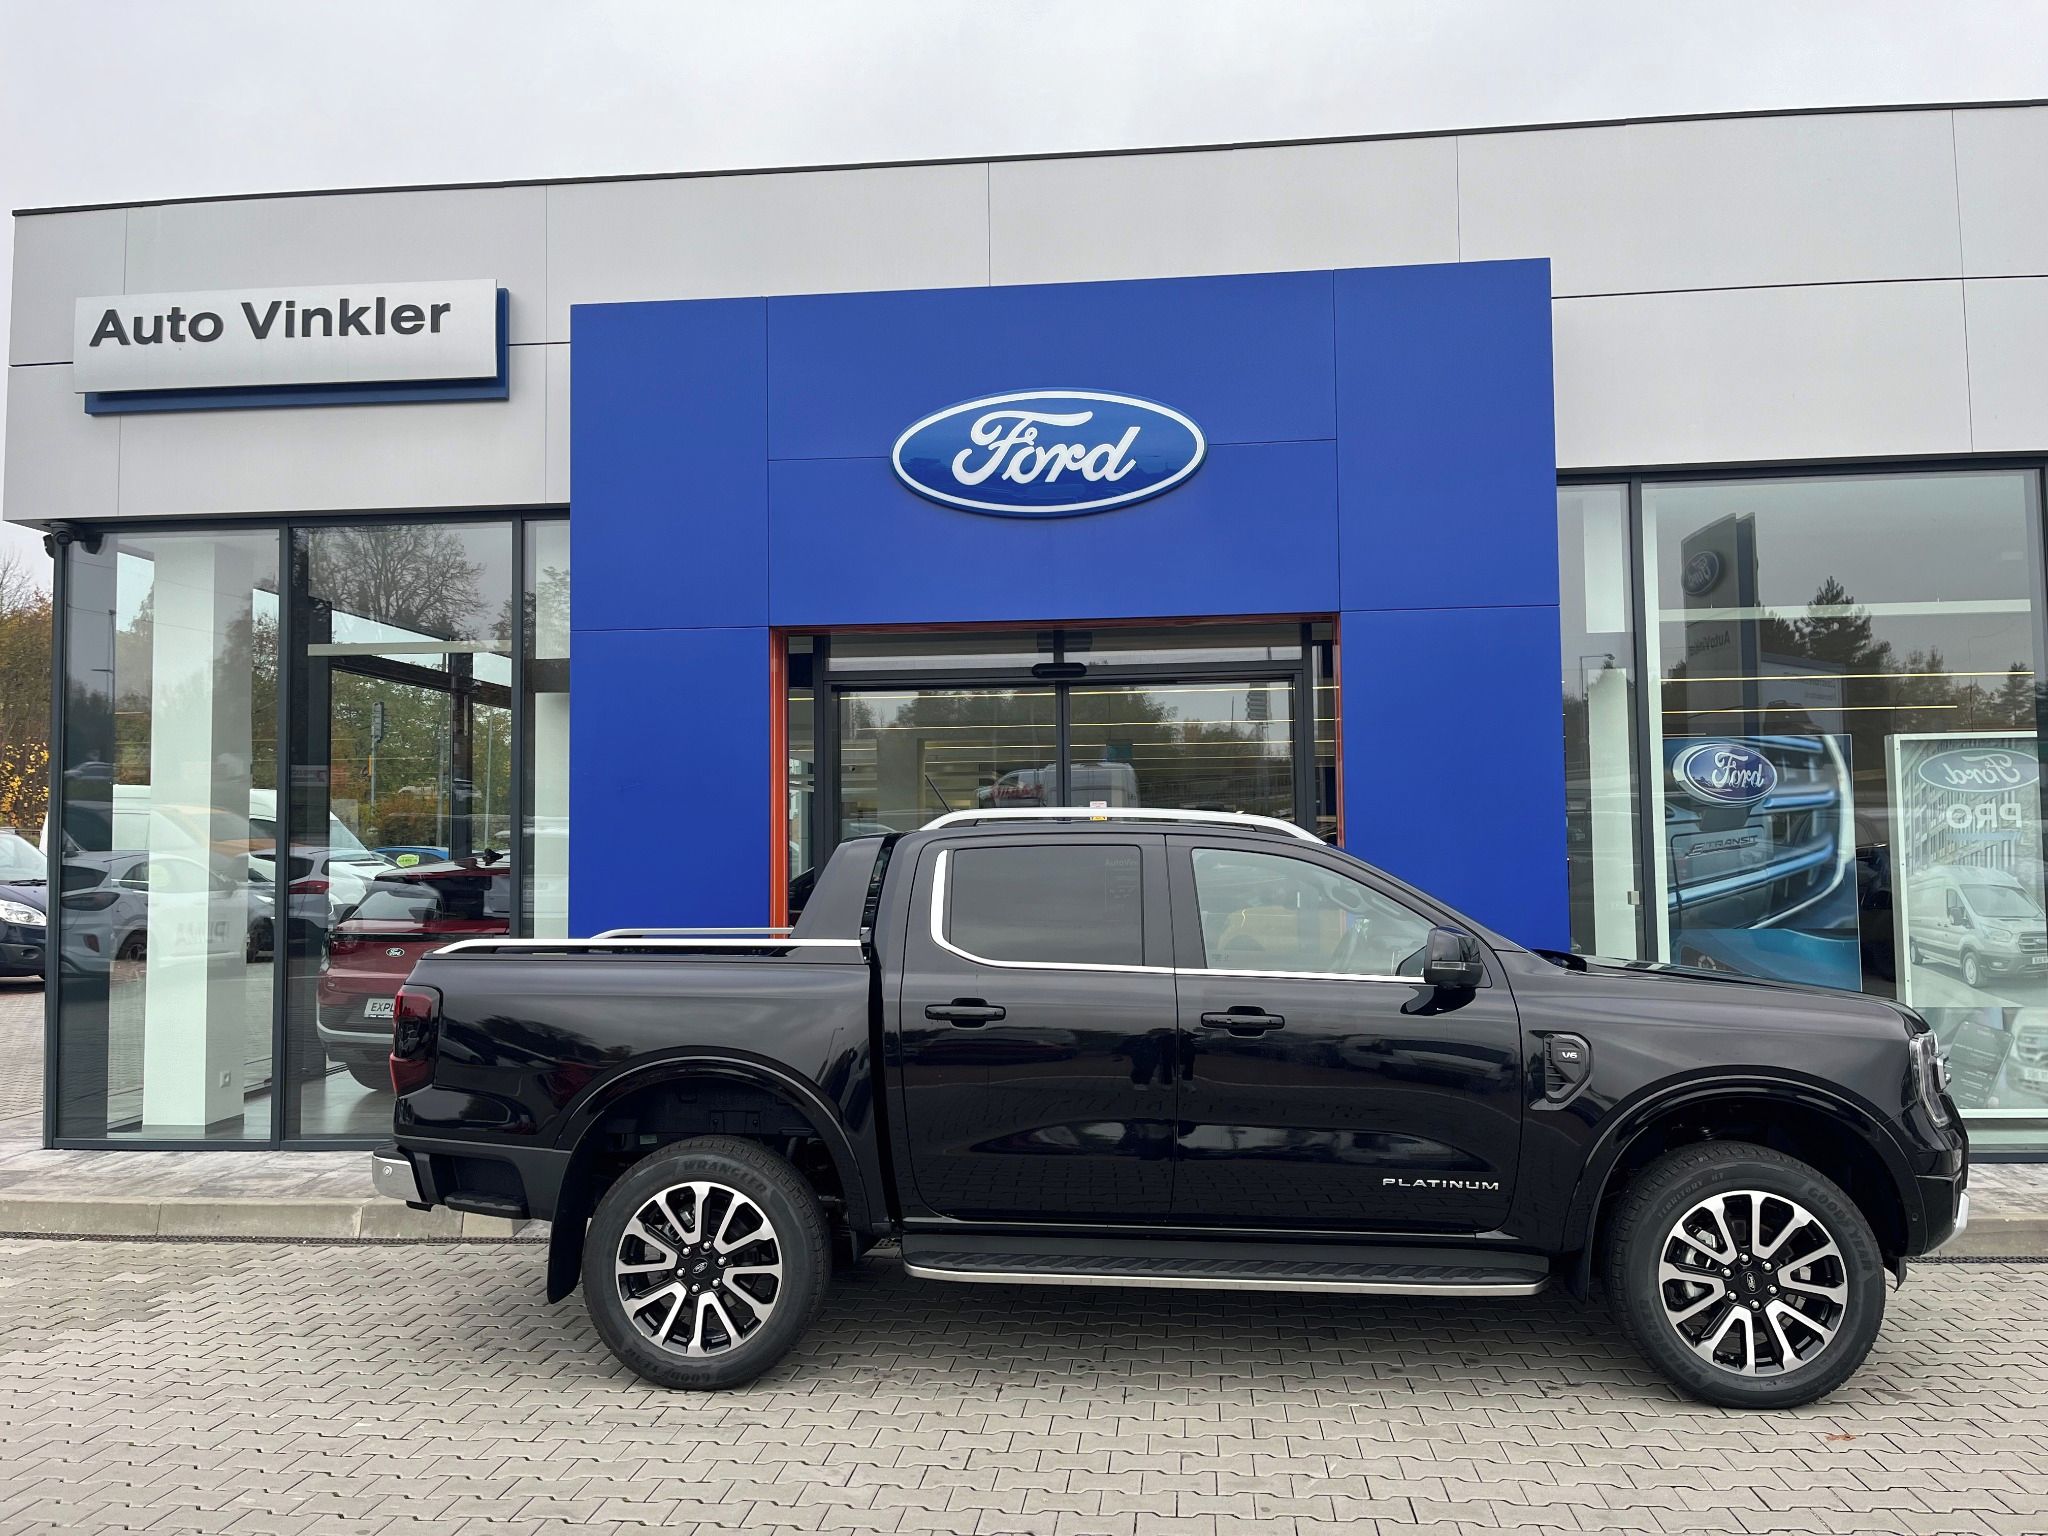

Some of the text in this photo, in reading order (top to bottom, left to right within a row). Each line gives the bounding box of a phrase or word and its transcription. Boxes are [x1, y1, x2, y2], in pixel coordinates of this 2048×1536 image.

[89, 296, 452, 347] Auto Vinkler
[951, 410, 1141, 486] Ford
[1711, 751, 1765, 788] Ford
[1562, 1051, 1578, 1059] V6
[684, 1160, 768, 1194] WRANGLER
[1382, 1178, 1499, 1191] PLATINUM
